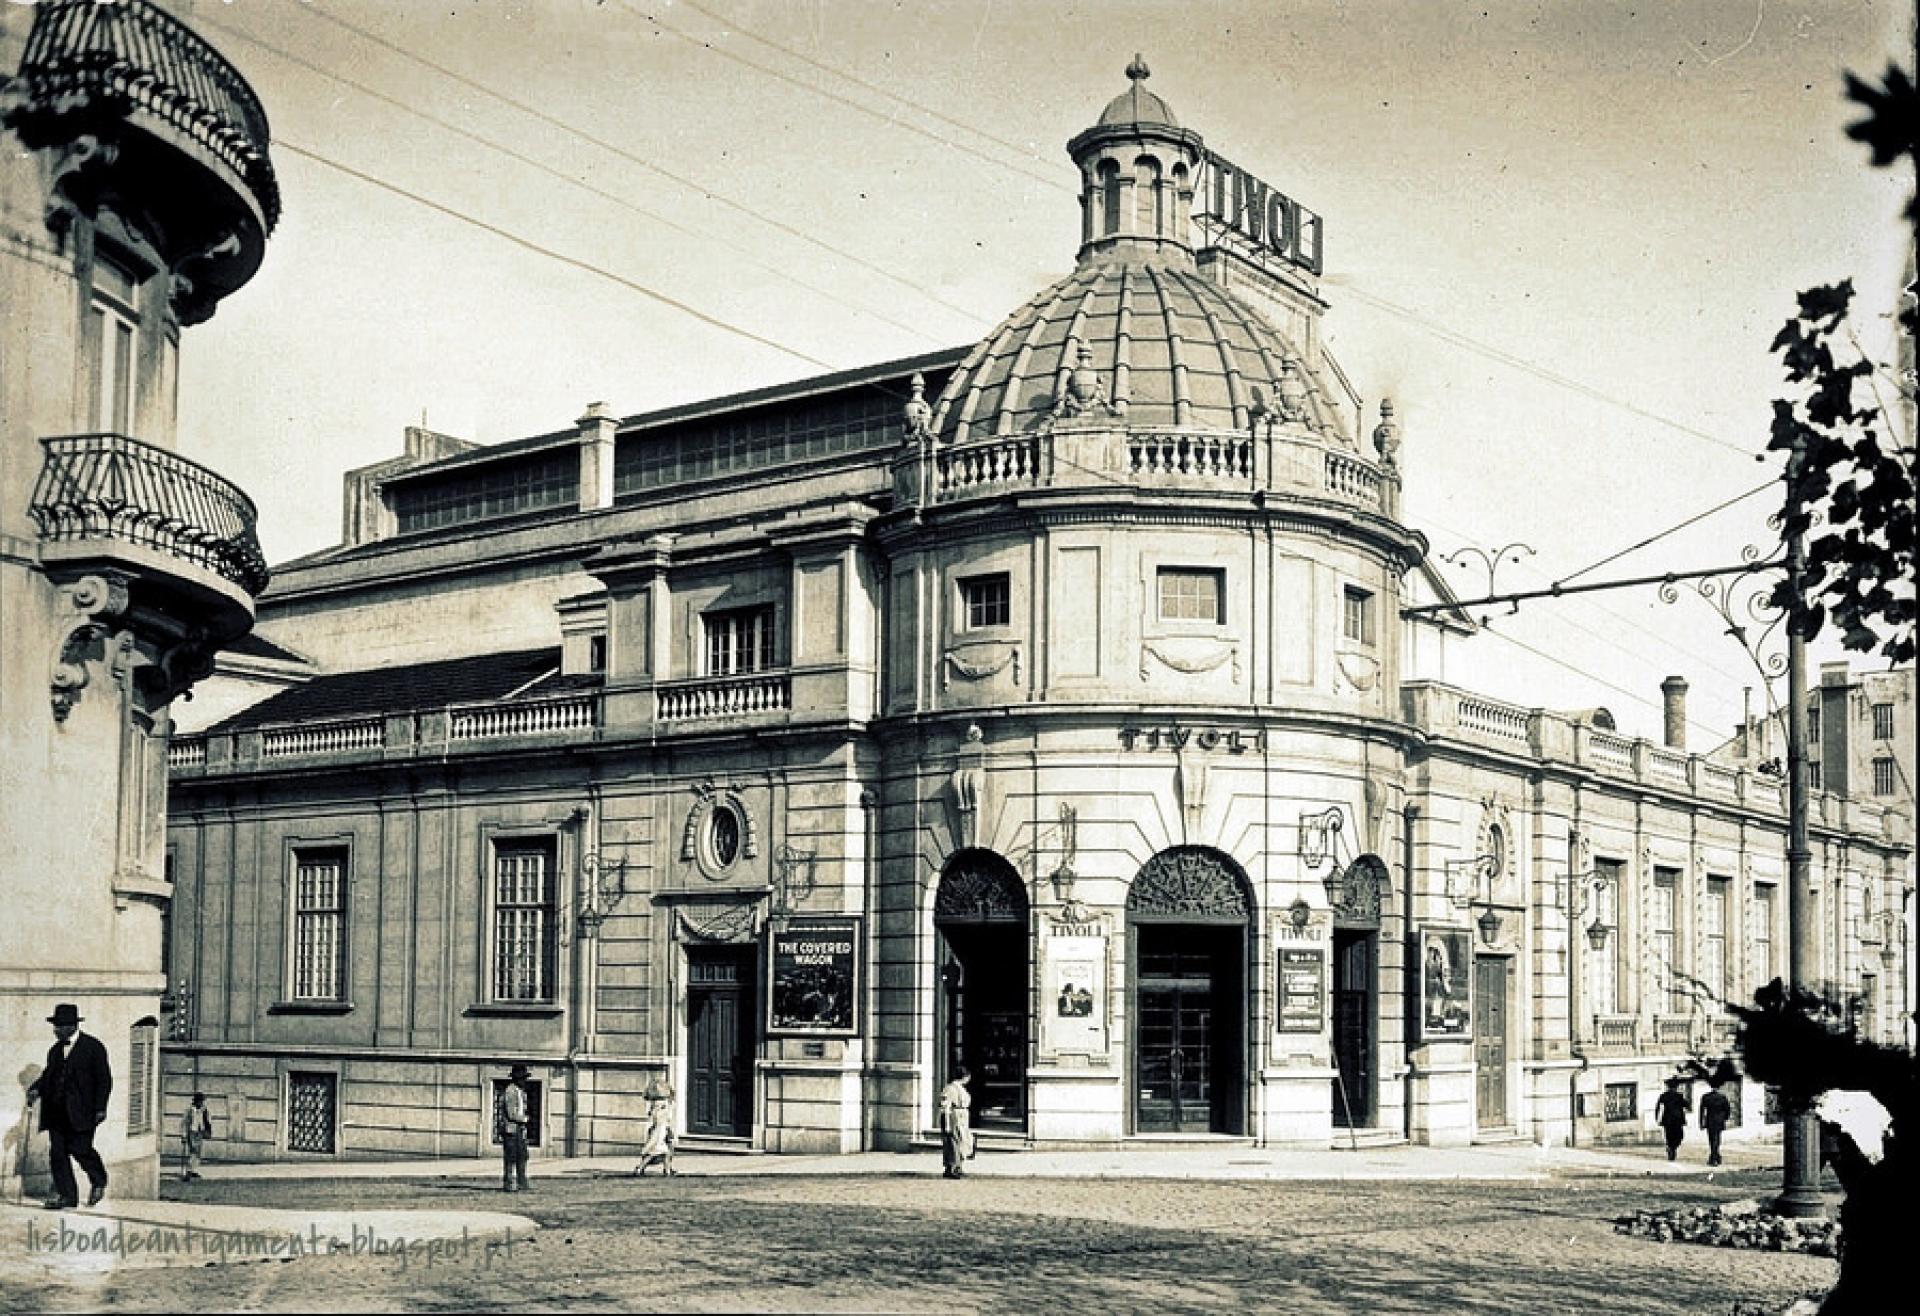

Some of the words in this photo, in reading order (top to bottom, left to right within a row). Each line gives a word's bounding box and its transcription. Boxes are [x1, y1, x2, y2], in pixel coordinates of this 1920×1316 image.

[1206, 150, 1324, 277] TIVOLI
[1118, 727, 1267, 755] TIVOLI
[1050, 924, 1101, 937] TIVOLI
[778, 942, 798, 954] THE
[800, 942, 852, 954] COVERED
[794, 954, 833, 965] WAGON
